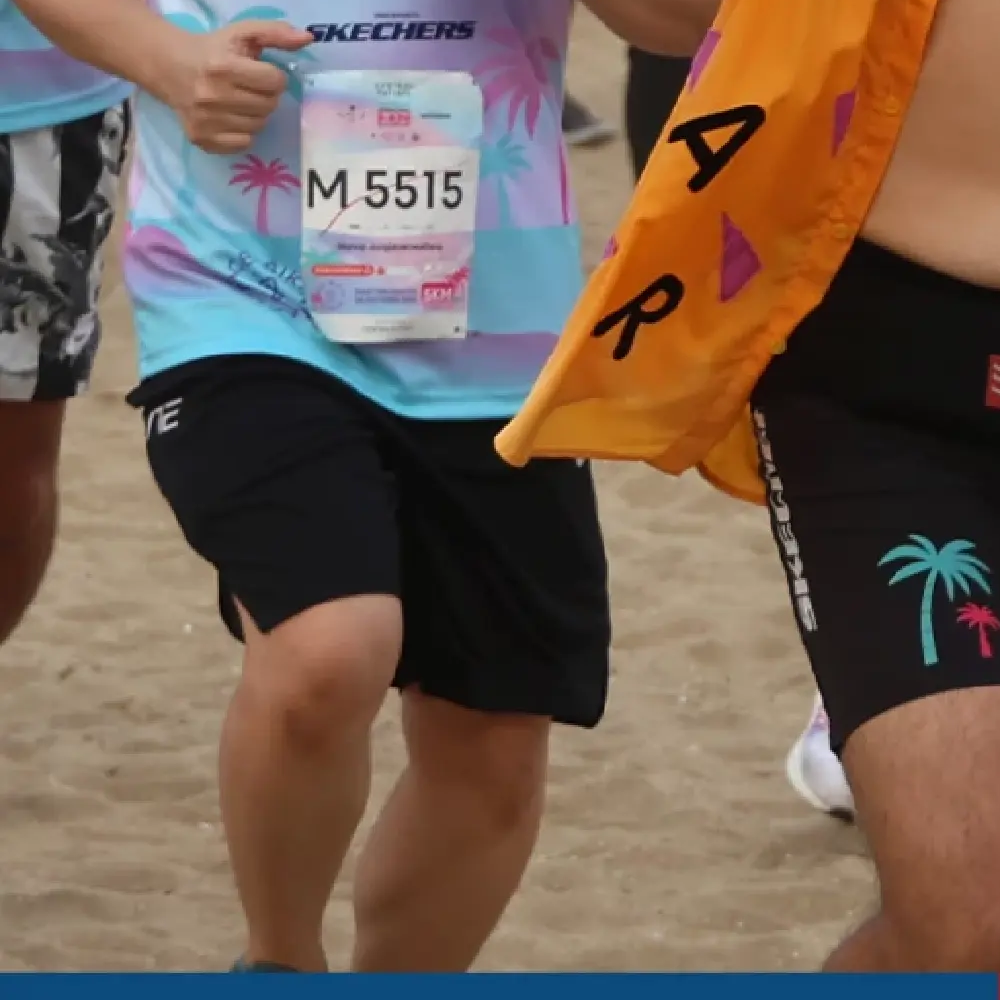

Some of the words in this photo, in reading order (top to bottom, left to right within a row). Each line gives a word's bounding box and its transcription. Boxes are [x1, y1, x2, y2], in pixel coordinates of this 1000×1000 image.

[306, 20, 478, 41] SKECHERS
[667, 104, 766, 193] A
[307, 168, 348, 209] M
[364, 169, 463, 209] 5515
[590, 274, 685, 361] R
